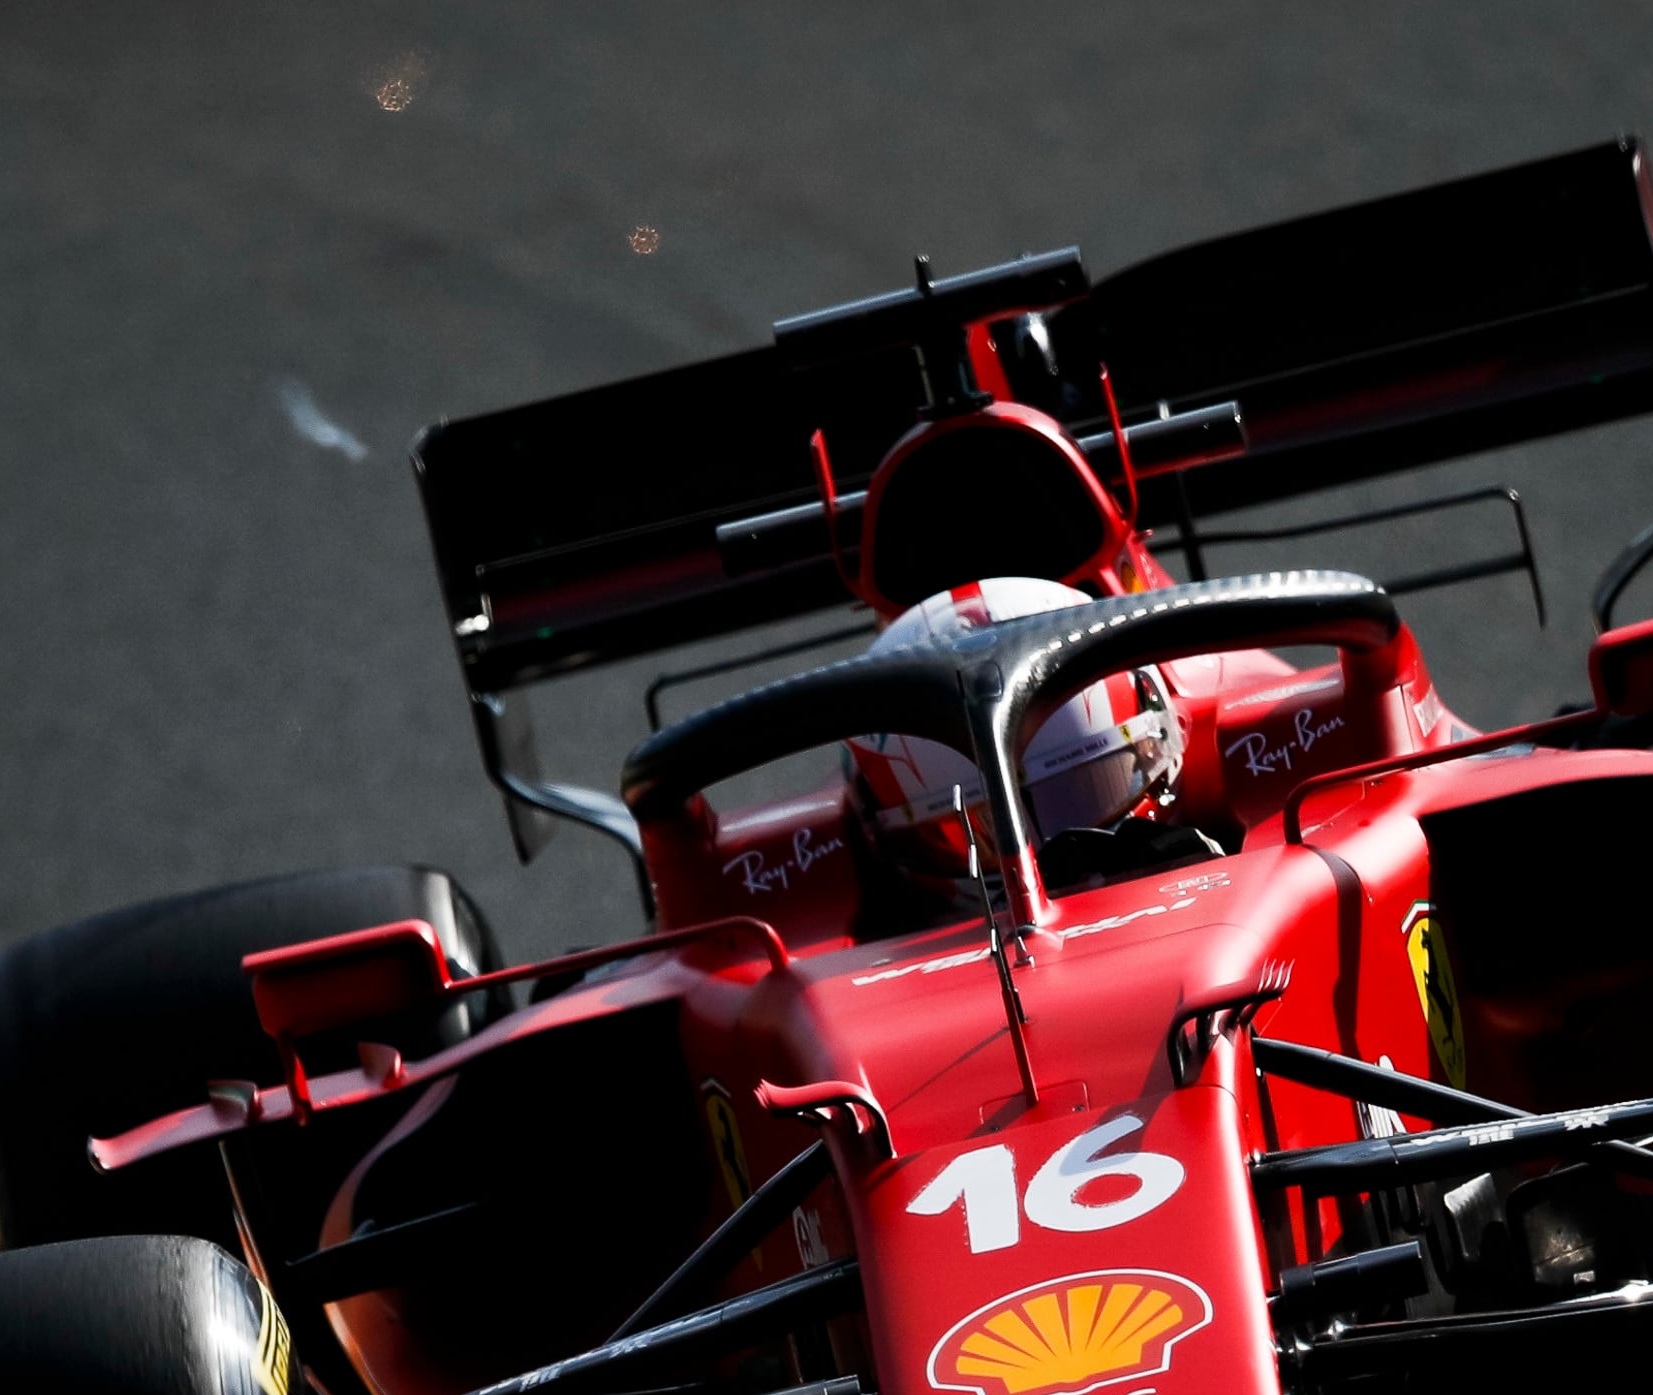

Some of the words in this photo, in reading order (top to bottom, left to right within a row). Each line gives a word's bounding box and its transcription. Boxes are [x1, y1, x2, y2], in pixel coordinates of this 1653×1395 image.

[1225, 709, 1345, 777] Ray-Ban
[722, 828, 843, 894] Ray-Ban
[905, 1111, 1185, 1254] 16
